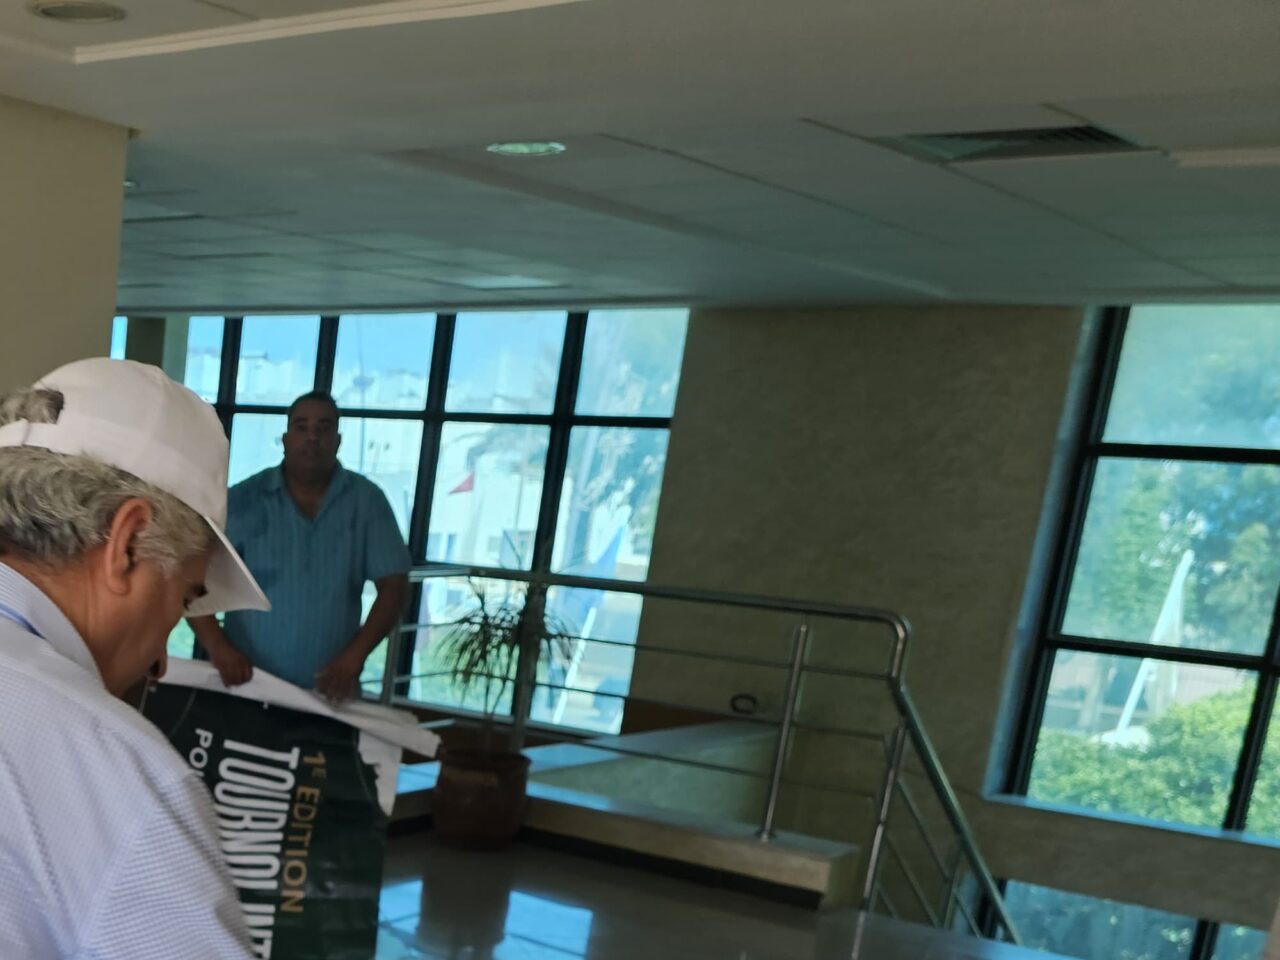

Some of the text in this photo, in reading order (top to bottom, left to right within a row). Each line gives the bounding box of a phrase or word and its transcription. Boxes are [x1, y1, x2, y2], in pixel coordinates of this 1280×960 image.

[189, 728, 213, 778] PO
[214, 739, 300, 890] TOURNOI
[280, 785, 321, 913] EDITION
